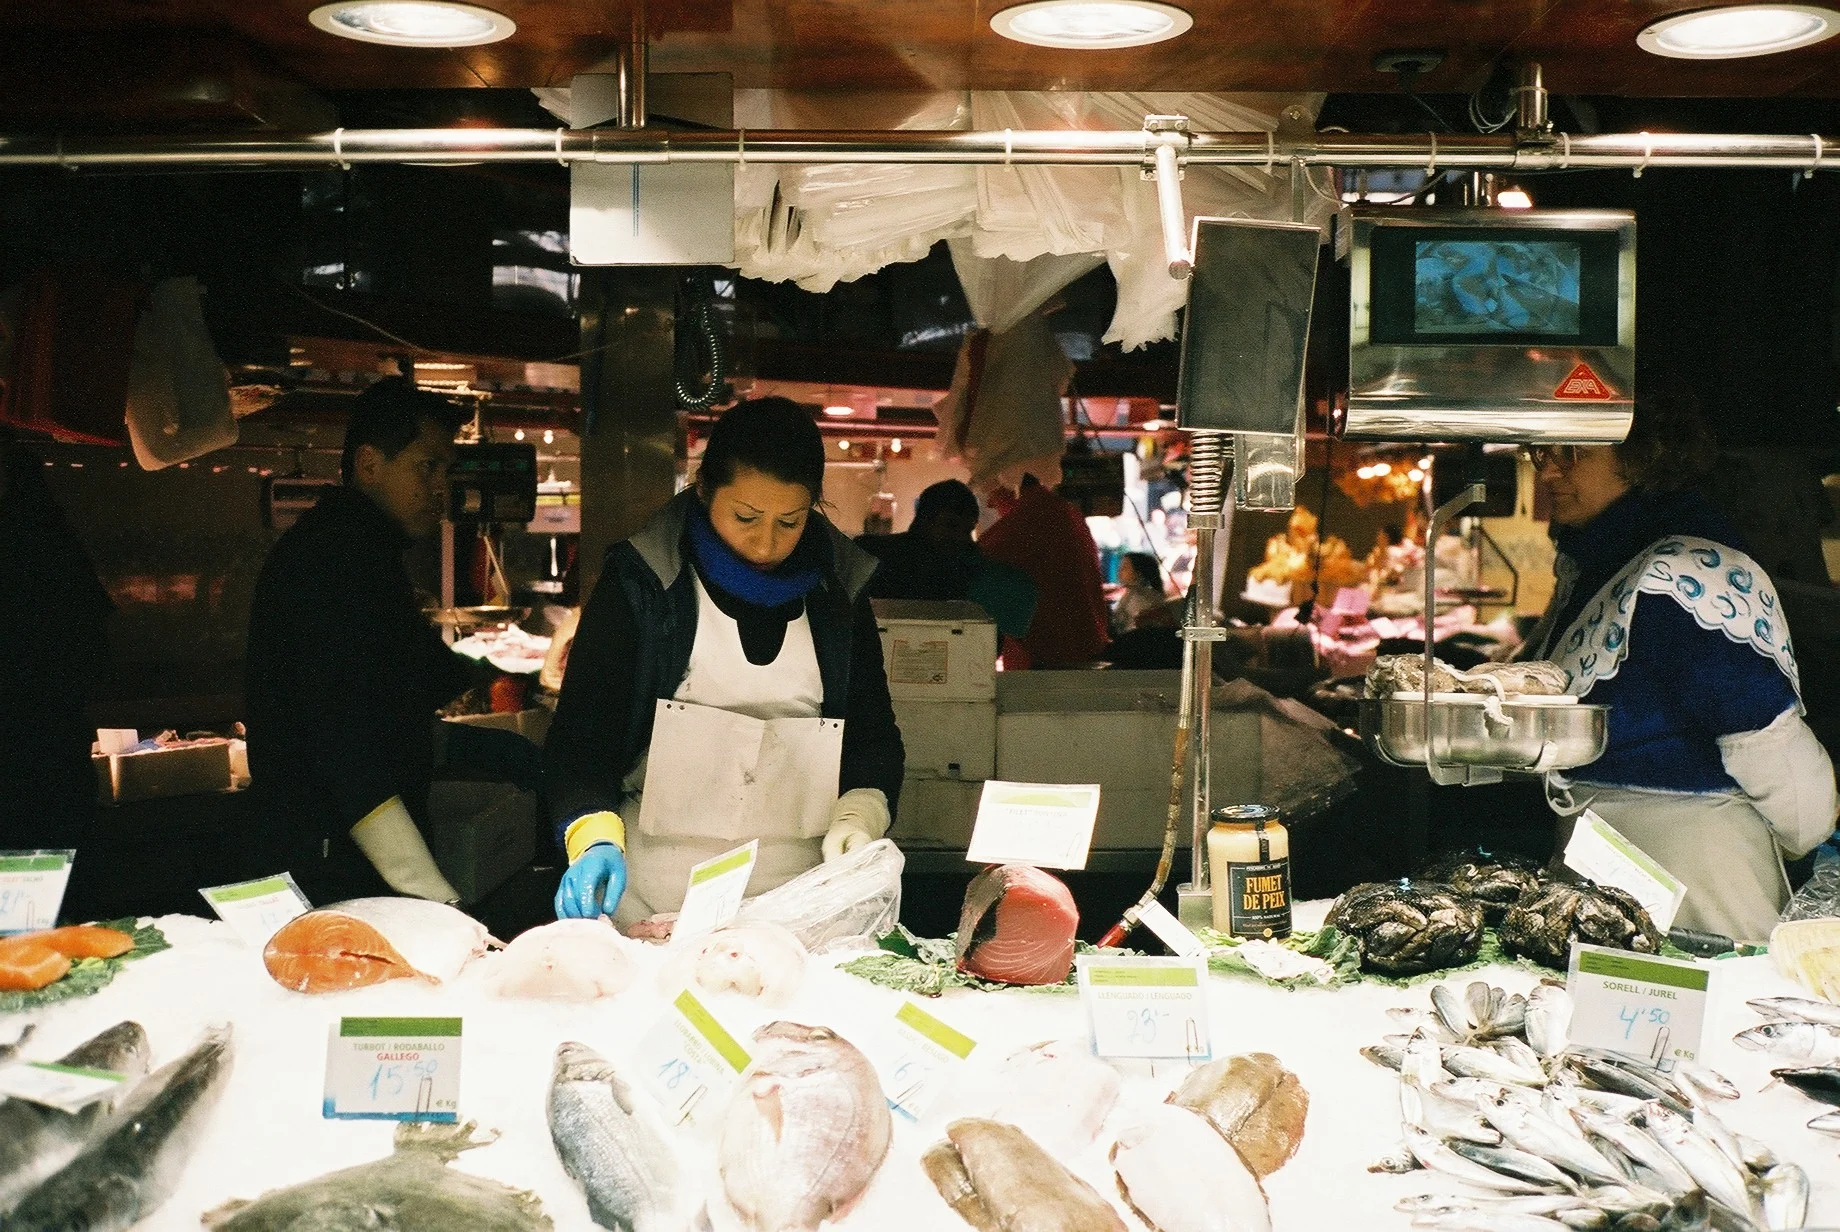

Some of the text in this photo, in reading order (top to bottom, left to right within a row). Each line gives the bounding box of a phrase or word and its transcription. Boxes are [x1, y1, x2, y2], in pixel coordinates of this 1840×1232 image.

[1245, 874, 1282, 893] FUMET
[1243, 891, 1286, 910] DE PEIX
[1603, 981, 1640, 994] SORELL
[1649, 988, 1678, 1000] JUREL
[1098, 991, 1144, 1000] LLENGUADO
[1151, 991, 1193, 1000] LENGUADO
[353, 1043, 385, 1051] TURBOT
[394, 1043, 445, 1051] RODABALLO
[376, 1052, 420, 1061] GALLEGO
[1683, 1050, 1695, 1060] Kg
[446, 1100, 457, 1109] Kg
